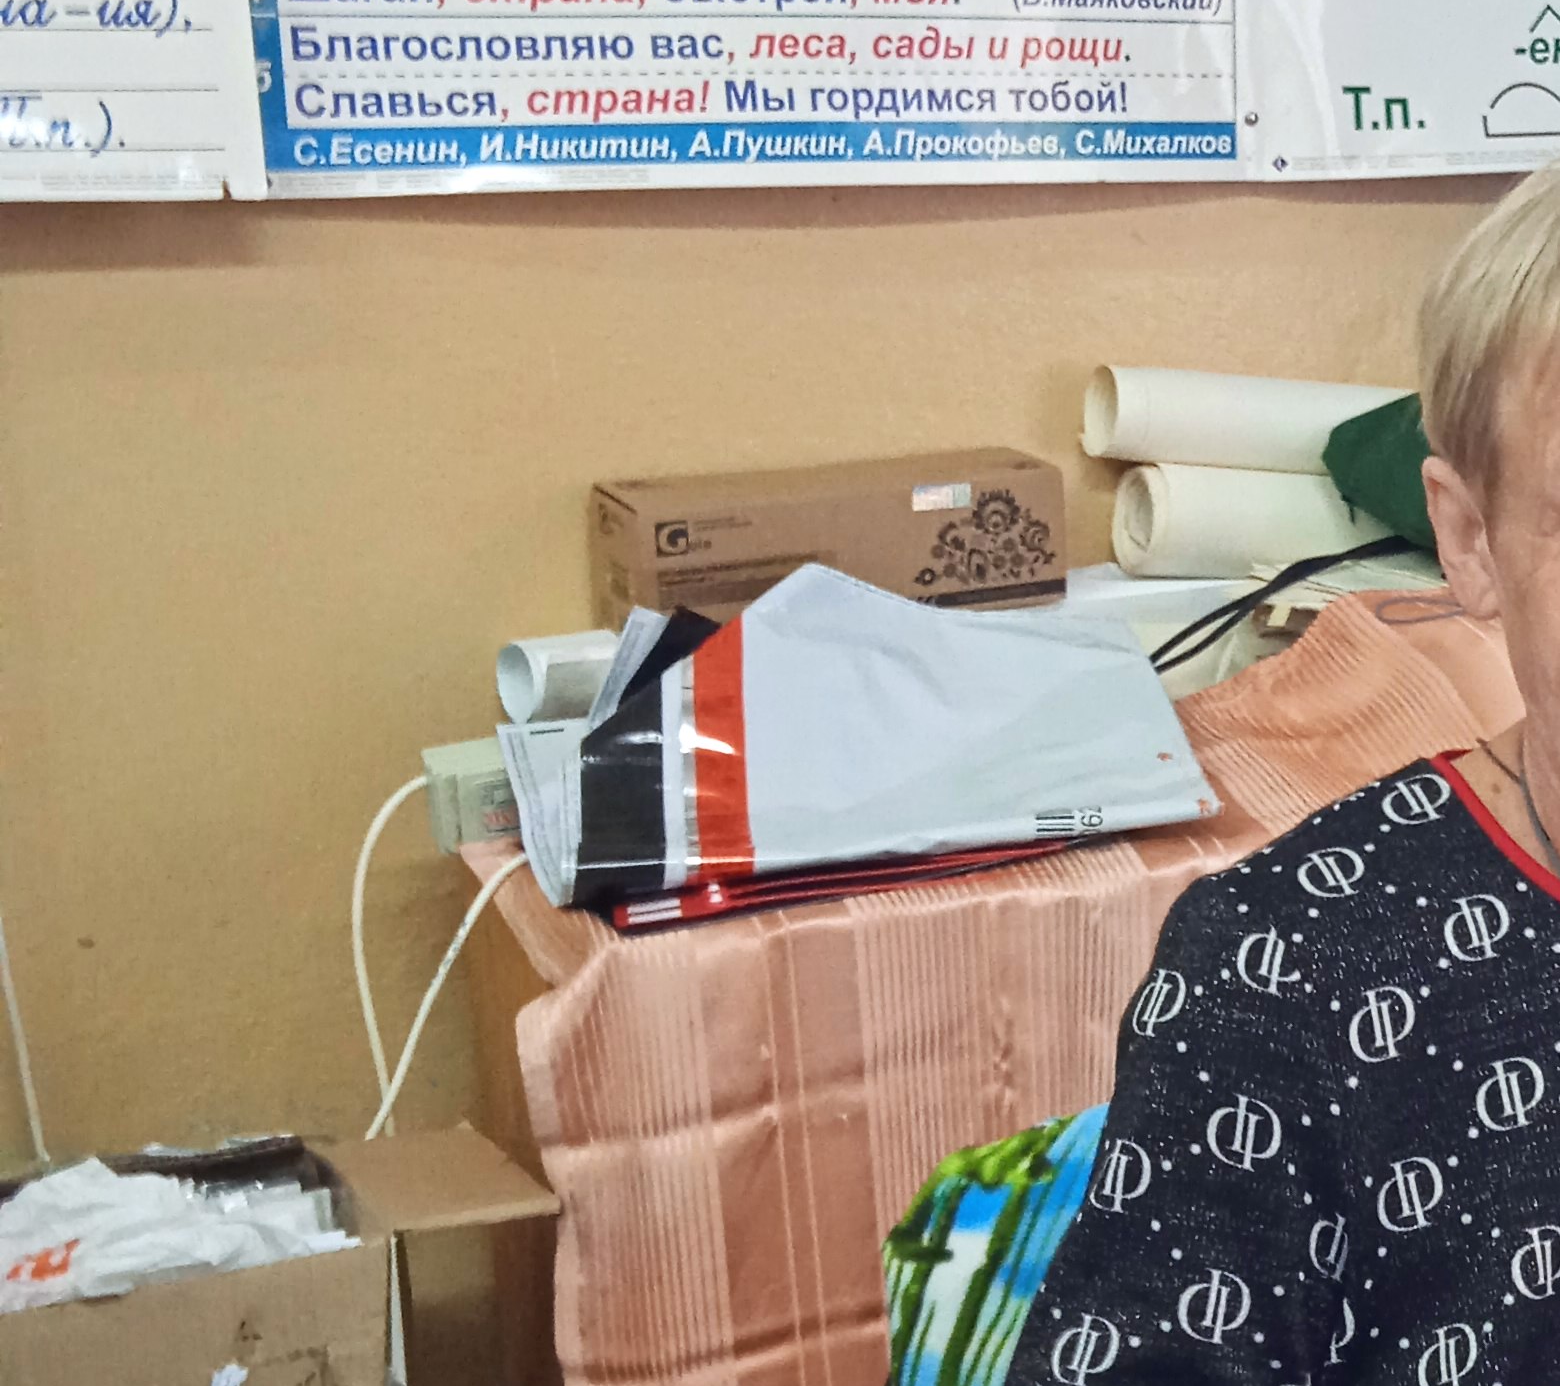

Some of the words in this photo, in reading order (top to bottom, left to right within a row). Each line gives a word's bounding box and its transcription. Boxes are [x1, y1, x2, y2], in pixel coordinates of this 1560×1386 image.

[290, 24, 635, 63] Благословляю
[650, 31, 736, 66] вас,
[748, 32, 858, 66] леса,
[872, 25, 975, 60] сады
[987, 33, 1009, 61] и
[1020, 33, 1131, 69] рощи.
[293, 81, 511, 123] Славься,
[526, 79, 711, 122] страна!
[725, 80, 795, 112] Мы
[810, 85, 997, 120] гордимся
[1009, 80, 1129, 114] тобой!
[1342, 85, 1427, 132] Т.п.
[292, 133, 468, 169] С.Есенин,
[479, 131, 679, 167] И.Никитин,
[688, 128, 855, 164] А.Пушкин,
[863, 127, 1067, 164] А.Прокофьев,
[1074, 127, 1233, 158] С.Михалков
